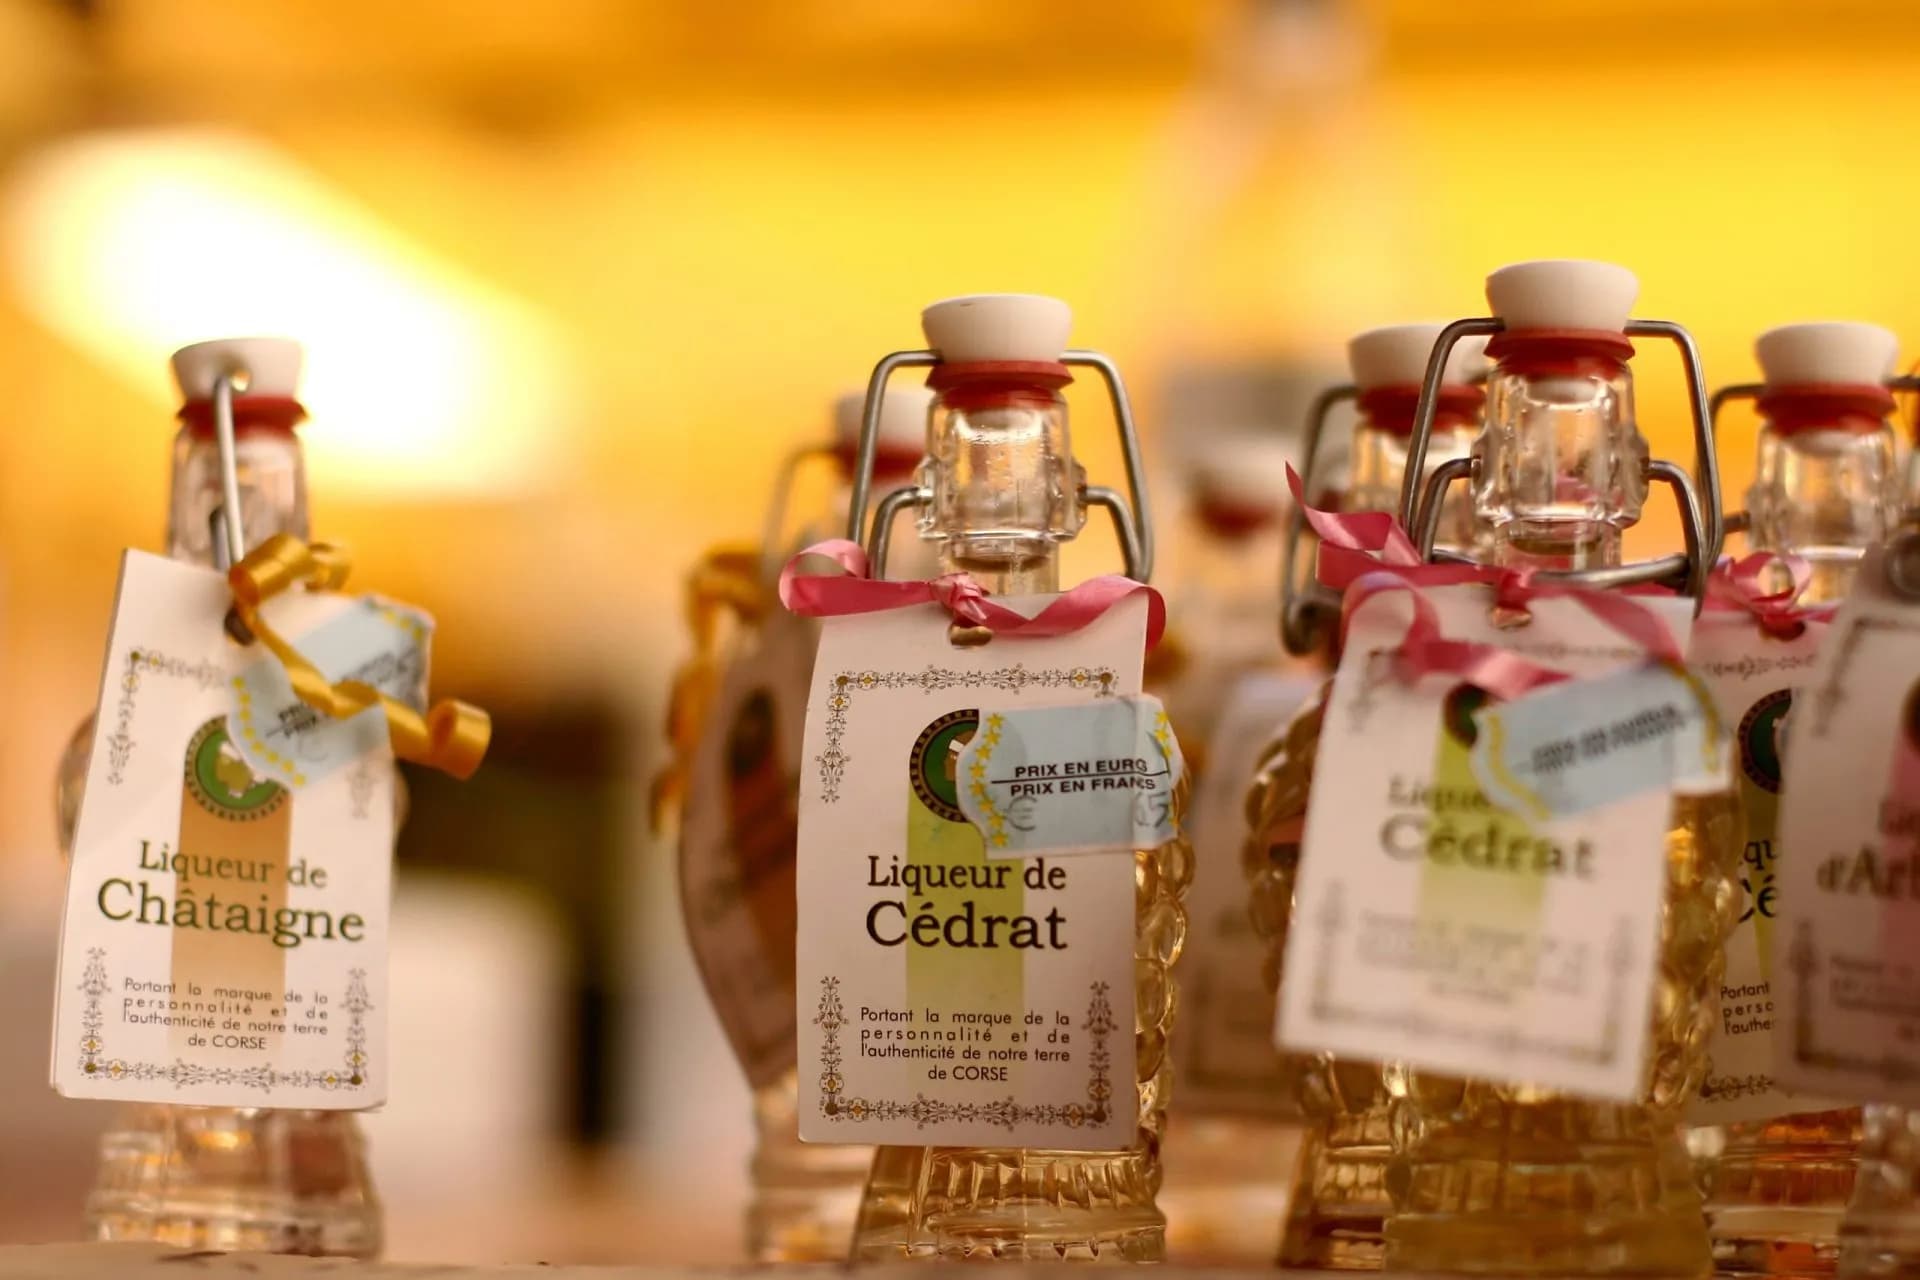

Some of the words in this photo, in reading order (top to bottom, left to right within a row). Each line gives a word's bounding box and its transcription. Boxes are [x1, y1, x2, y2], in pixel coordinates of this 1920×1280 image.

[1015, 763, 1058, 778] PRIX
[1064, 761, 1089, 774] EN
[1011, 781, 1053, 796] PRIX
[1060, 779, 1085, 793] EN
[138, 840, 275, 883] Liqueur
[286, 858, 328, 889] de
[867, 855, 1012, 896] Liqueur
[1024, 857, 1066, 890] de
[97, 878, 365, 949] Châtaigne
[866, 900, 1068, 949] Cédrat
[124, 977, 177, 994] Portant
[188, 982, 202, 996] la
[214, 986, 273, 1004] marque
[284, 989, 303, 1004] de
[315, 992, 329, 1005] la
[124, 997, 253, 1016] personnalité
[270, 1006, 287, 1018] et
[306, 1007, 328, 1020] de
[861, 1007, 913, 1023] Portant
[925, 1008, 939, 1023] la
[952, 1011, 1012, 1027] marque
[1024, 1010, 1043, 1025] de
[1055, 1011, 1070, 1026] la
[123, 1006, 215, 1030] l'authenticité
[222, 1017, 241, 1031] de
[248, 1020, 286, 1033] notre
[293, 1024, 328, 1036] terre
[188, 1033, 207, 1048] de
[212, 1035, 267, 1050] CORSE
[861, 1027, 992, 1044] personnalité
[1011, 1030, 1028, 1043] et
[1047, 1029, 1070, 1043] de
[861, 1043, 955, 1060] l'authenticité
[962, 1045, 981, 1060] de
[988, 1046, 1028, 1061] notre
[1034, 1047, 1070, 1062] terre
[928, 1065, 947, 1080] de
[952, 1066, 1008, 1081] CORSE
